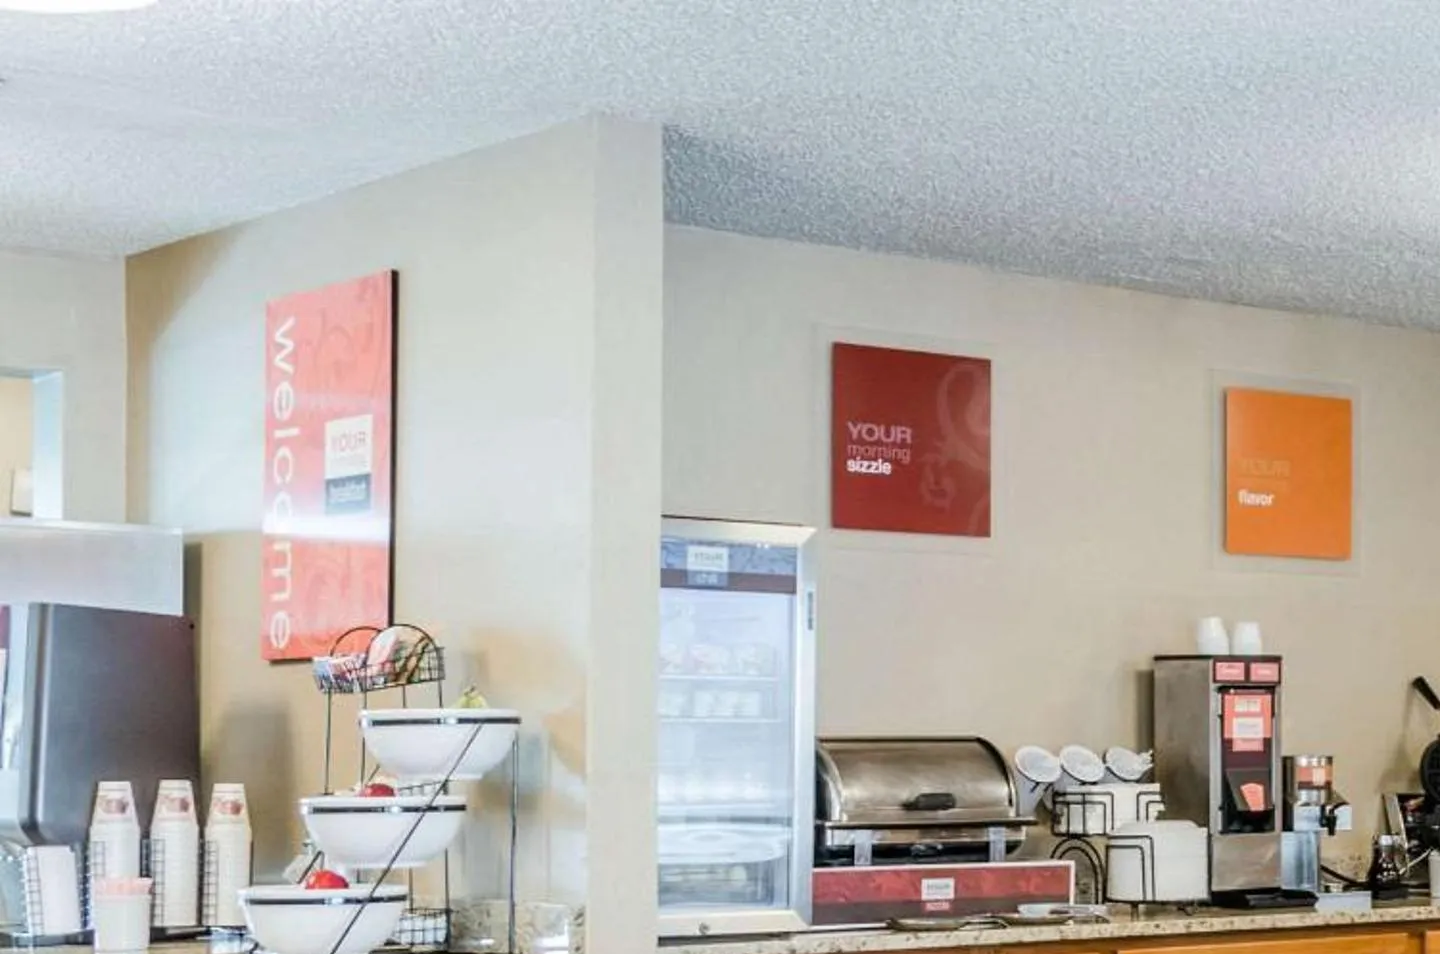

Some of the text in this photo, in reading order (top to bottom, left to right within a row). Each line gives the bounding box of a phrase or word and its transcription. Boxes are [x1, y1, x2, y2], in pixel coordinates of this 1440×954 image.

[847, 421, 912, 443] YOUR
[848, 444, 911, 464] morning
[847, 457, 892, 475] sizzle
[269, 316, 300, 649] welcome
